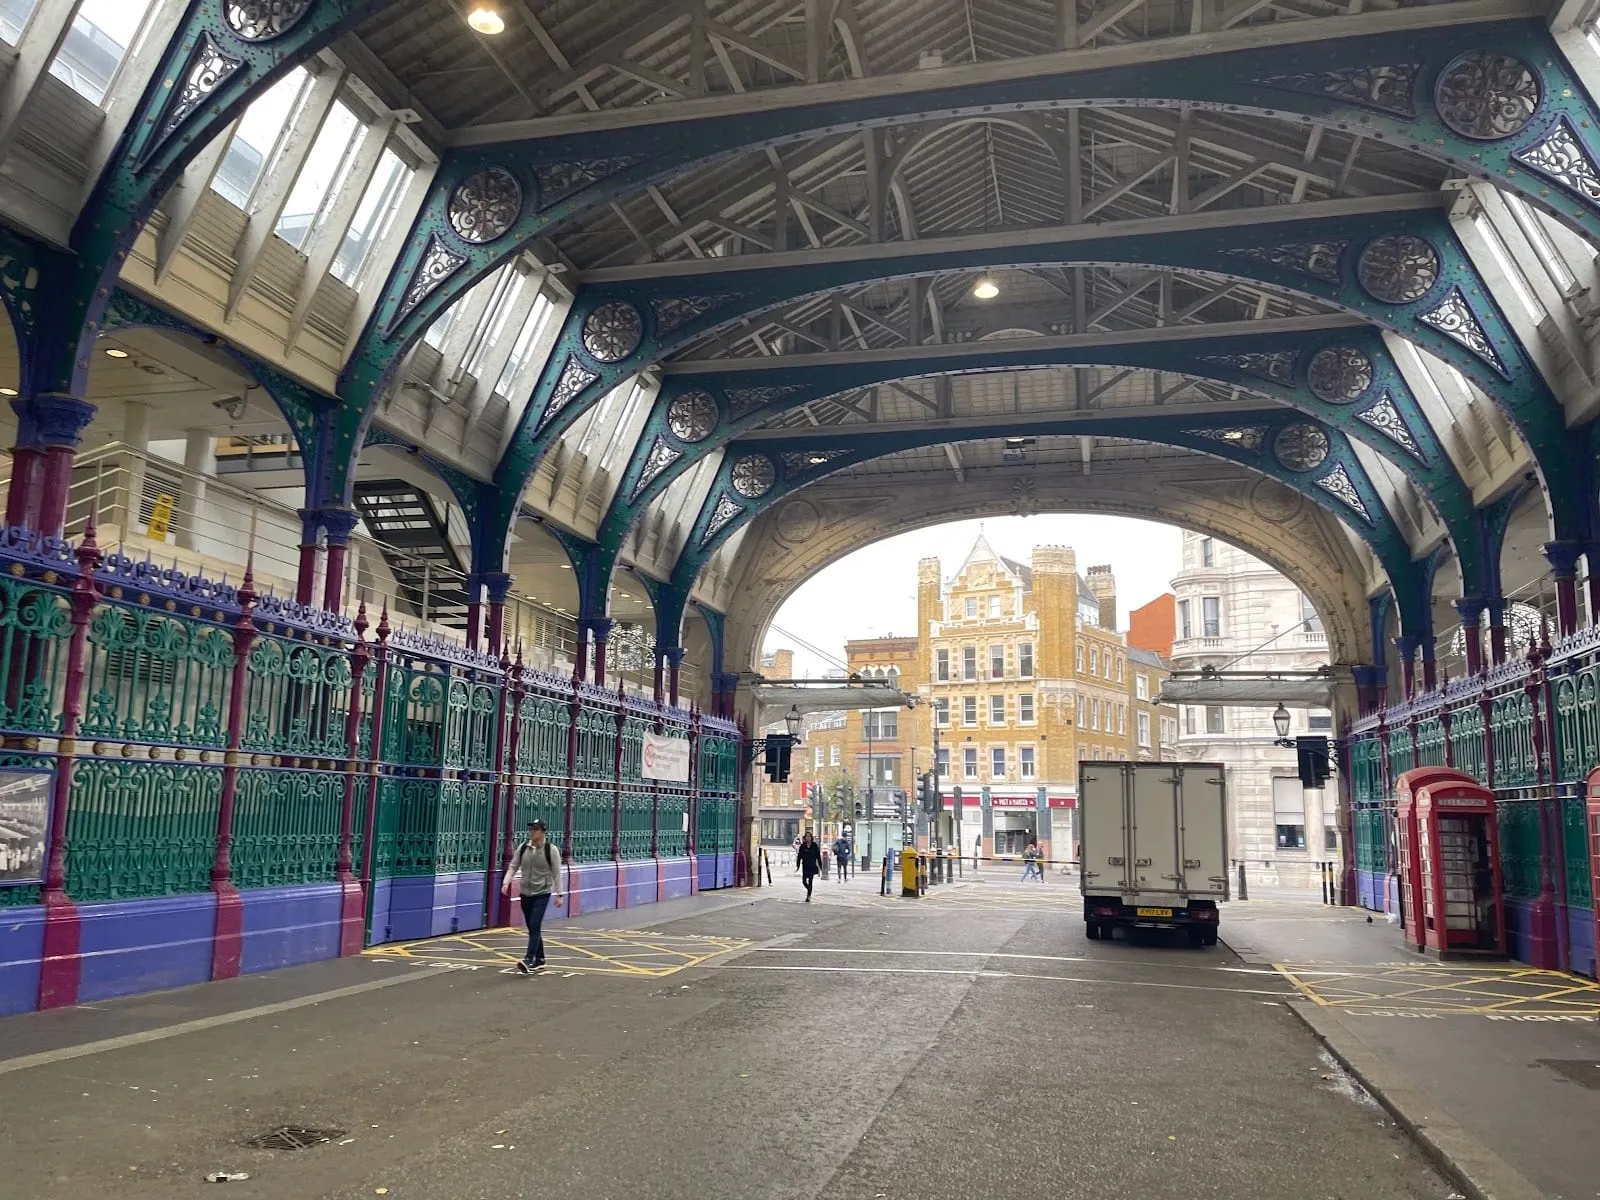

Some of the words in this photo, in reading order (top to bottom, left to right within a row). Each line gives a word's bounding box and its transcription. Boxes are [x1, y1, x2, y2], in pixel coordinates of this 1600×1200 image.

[410, 960, 486, 971] LOOK
[498, 967, 586, 978] LEFT
[1343, 1009, 1445, 1019] LOOK
[1485, 1014, 1594, 1022] RIGHT
